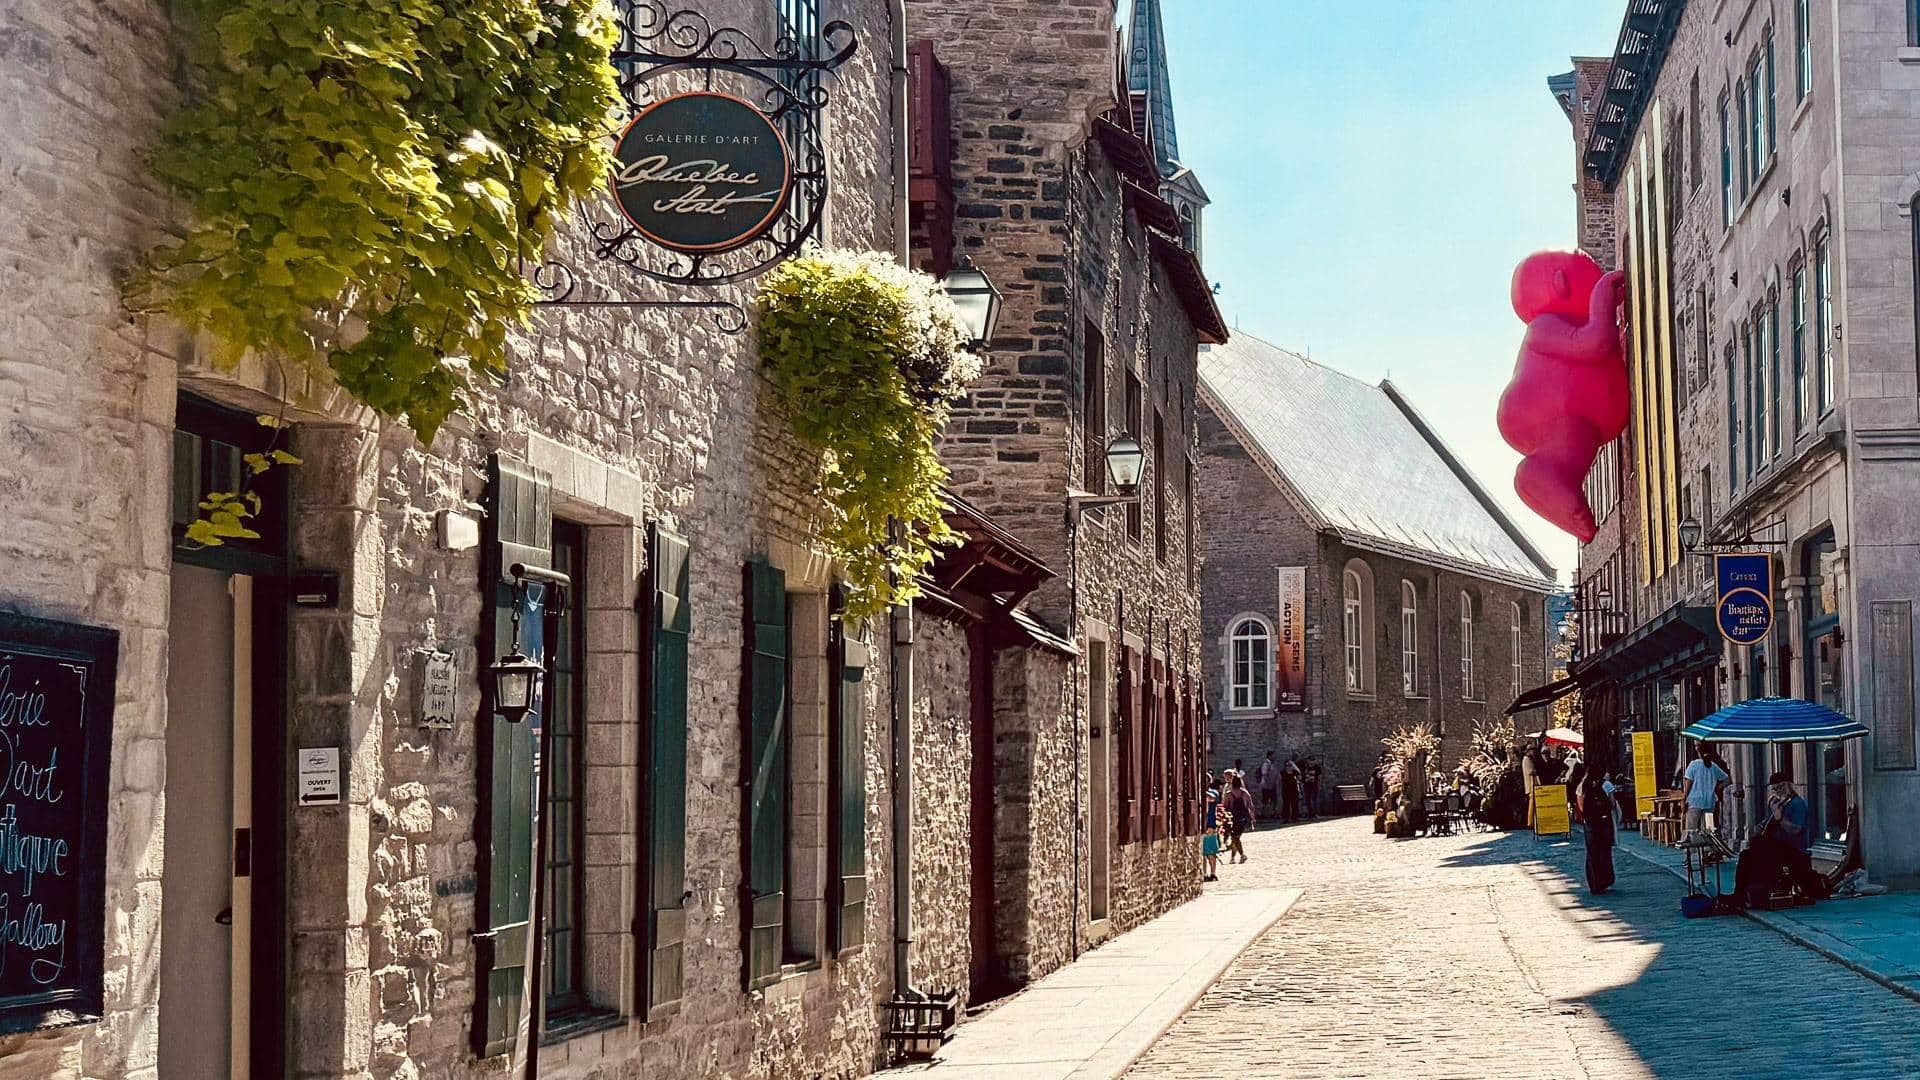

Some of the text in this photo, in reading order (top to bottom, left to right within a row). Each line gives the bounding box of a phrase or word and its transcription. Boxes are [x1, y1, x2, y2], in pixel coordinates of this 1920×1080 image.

[645, 134, 759, 145] GALERIE D'ART
[1284, 602, 1292, 645] ACTION
[1292, 641, 1300, 673] SENS
